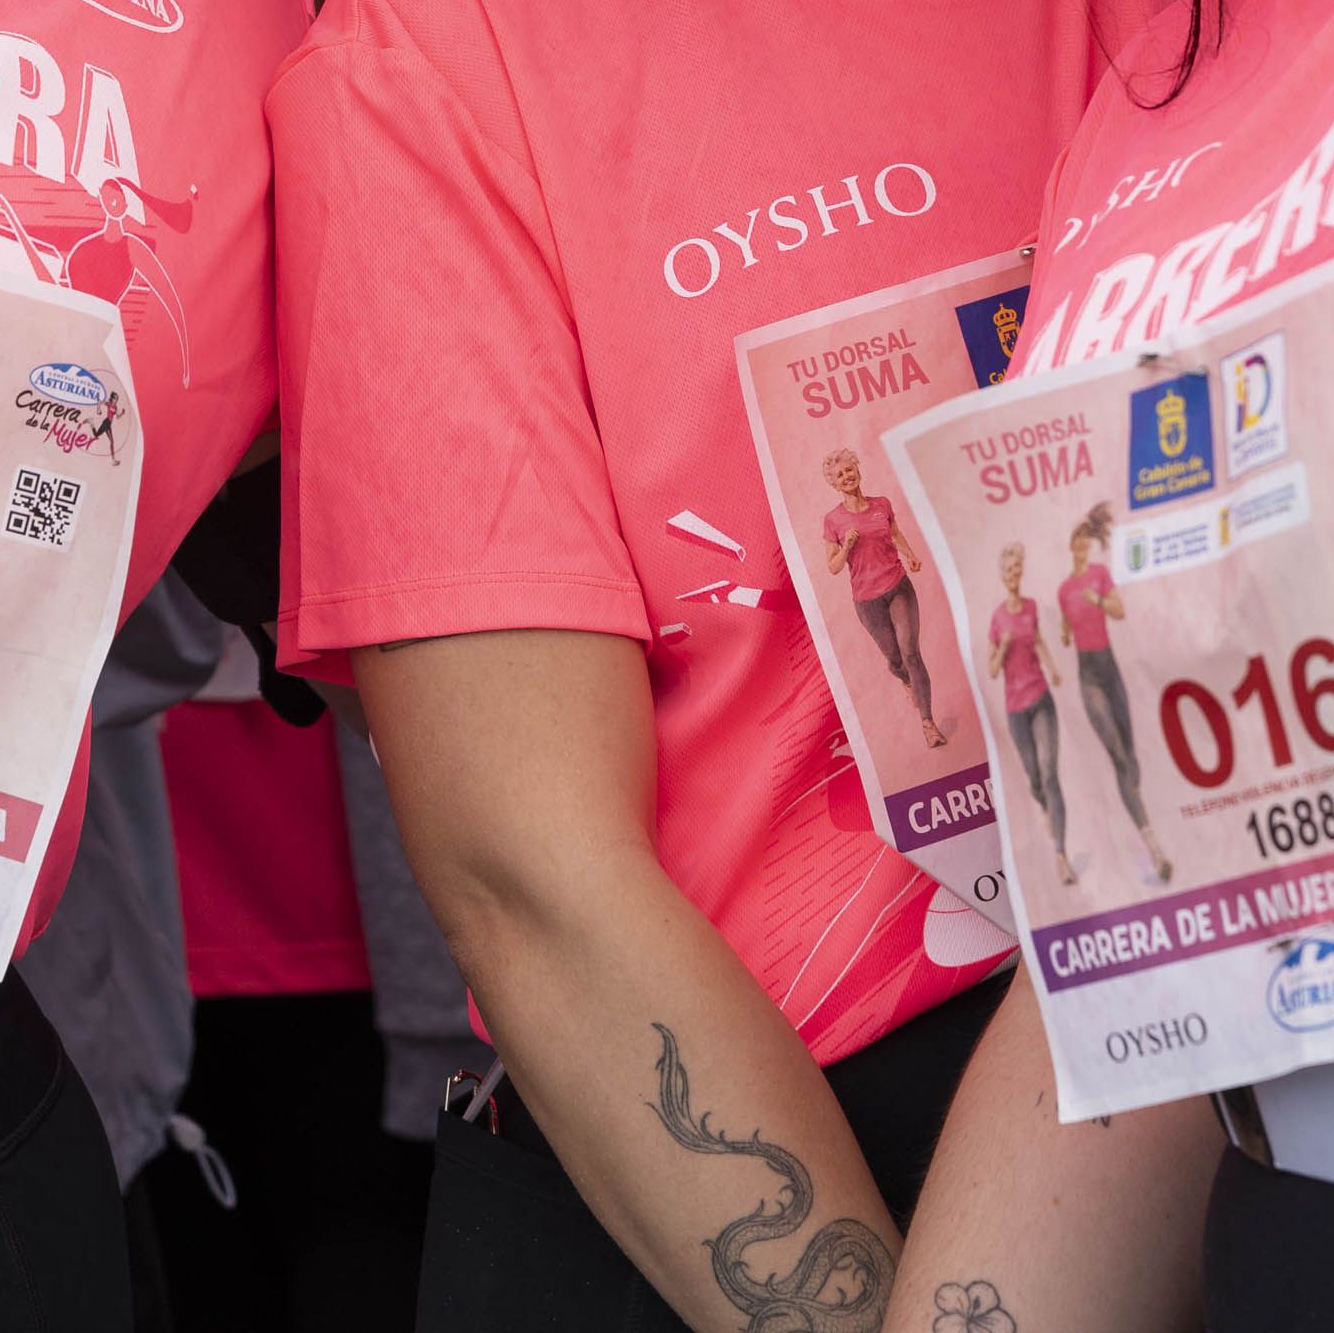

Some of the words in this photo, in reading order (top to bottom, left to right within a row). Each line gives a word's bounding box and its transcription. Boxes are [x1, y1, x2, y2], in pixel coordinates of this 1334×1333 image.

[664, 162, 937, 298] OYSHO
[786, 360, 818, 384] TU
[822, 327, 917, 372] DORSAL
[16, 390, 81, 424] Carrera
[35, 370, 101, 401] ASTURIANA
[802, 352, 931, 418] SUMA
[43, 418, 100, 454] Mujer
[960, 437, 997, 465] TU
[1001, 411, 1092, 455] DORSAL
[979, 439, 1094, 505] SUMA
[1049, 915, 1173, 978] CARRERA
[1175, 903, 1215, 947] DE
[1218, 893, 1258, 937] LA
[1106, 1012, 1208, 1064] OYSHO
